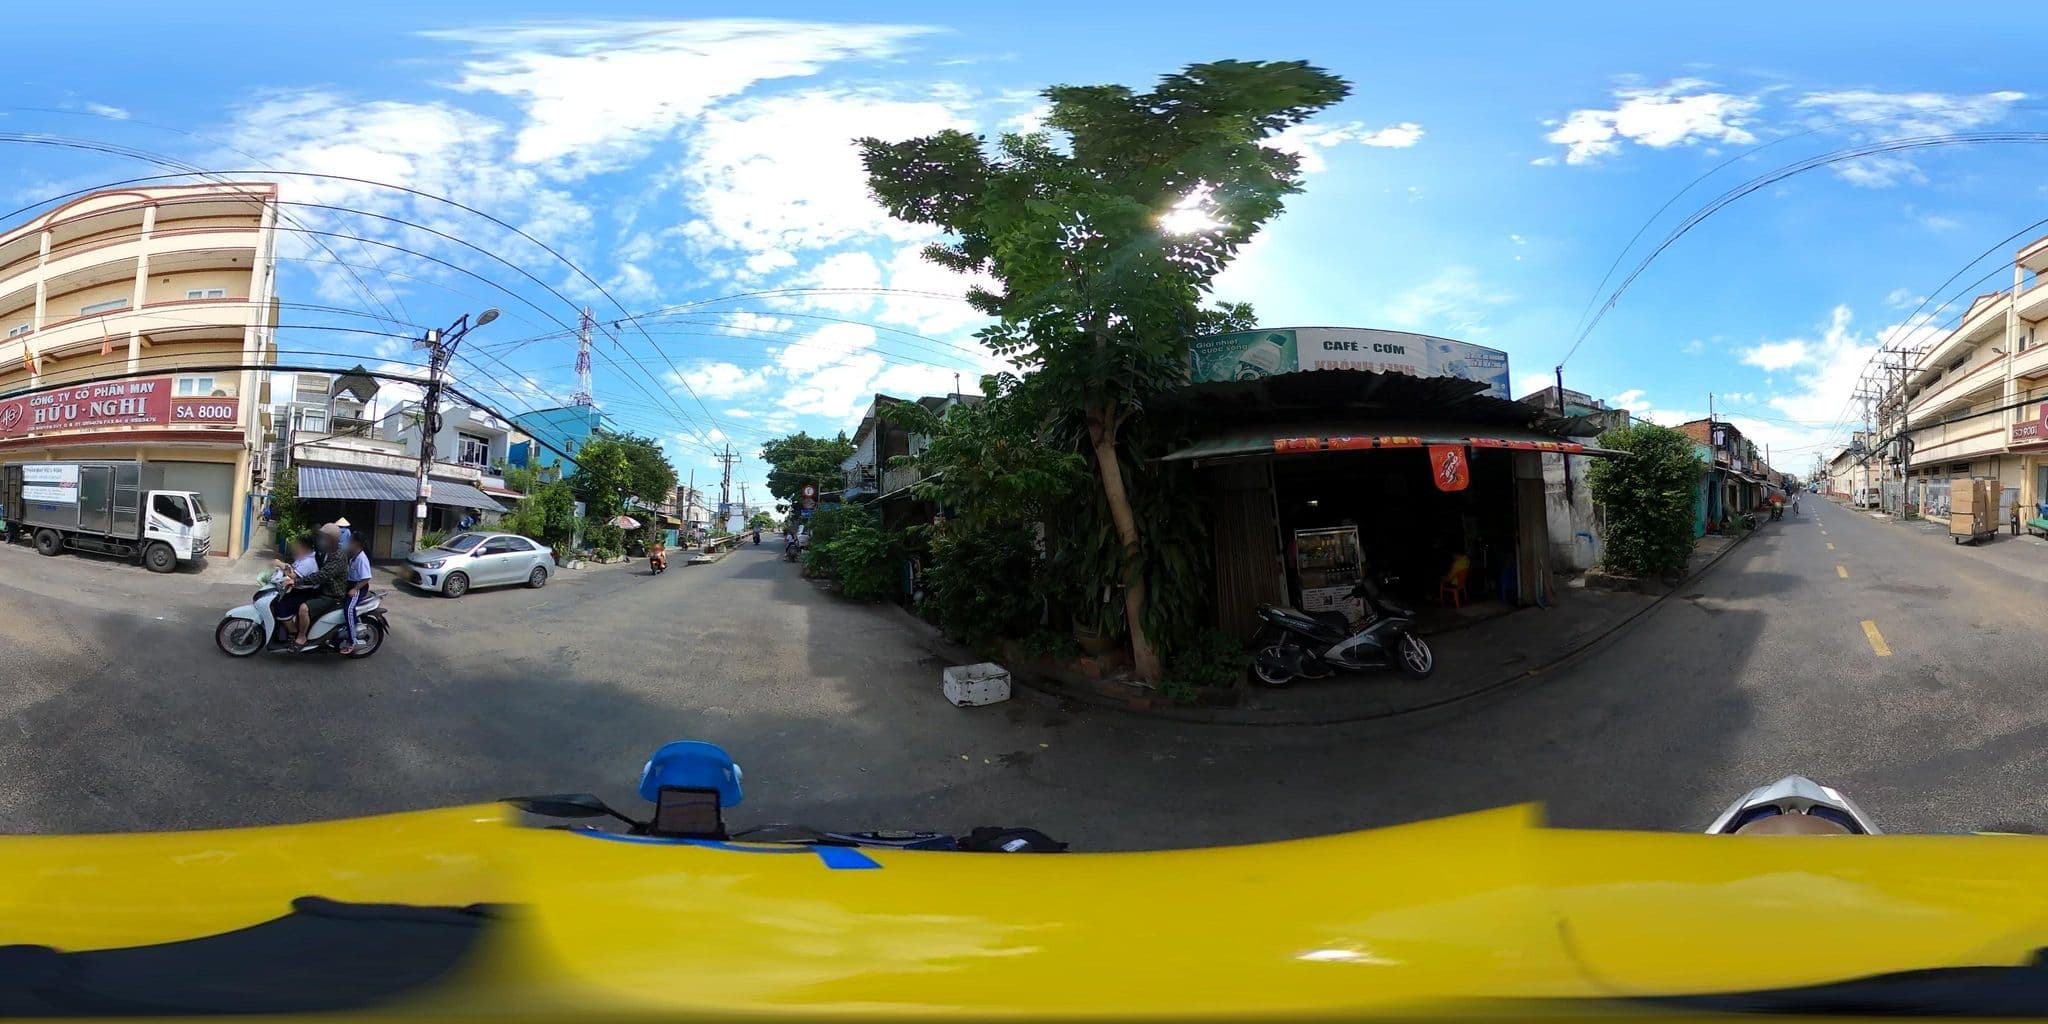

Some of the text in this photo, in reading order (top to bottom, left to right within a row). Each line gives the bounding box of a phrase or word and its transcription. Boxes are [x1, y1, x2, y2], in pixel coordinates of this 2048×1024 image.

[1373, 343, 1405, 355] CƠM
[31, 382, 155, 406] CÔNG TY CỔ PHẦN MAY
[34, 403, 79, 424] HỮU
[88, 397, 147, 417] NGHỊ
[176, 406, 232, 418] SA 8000
